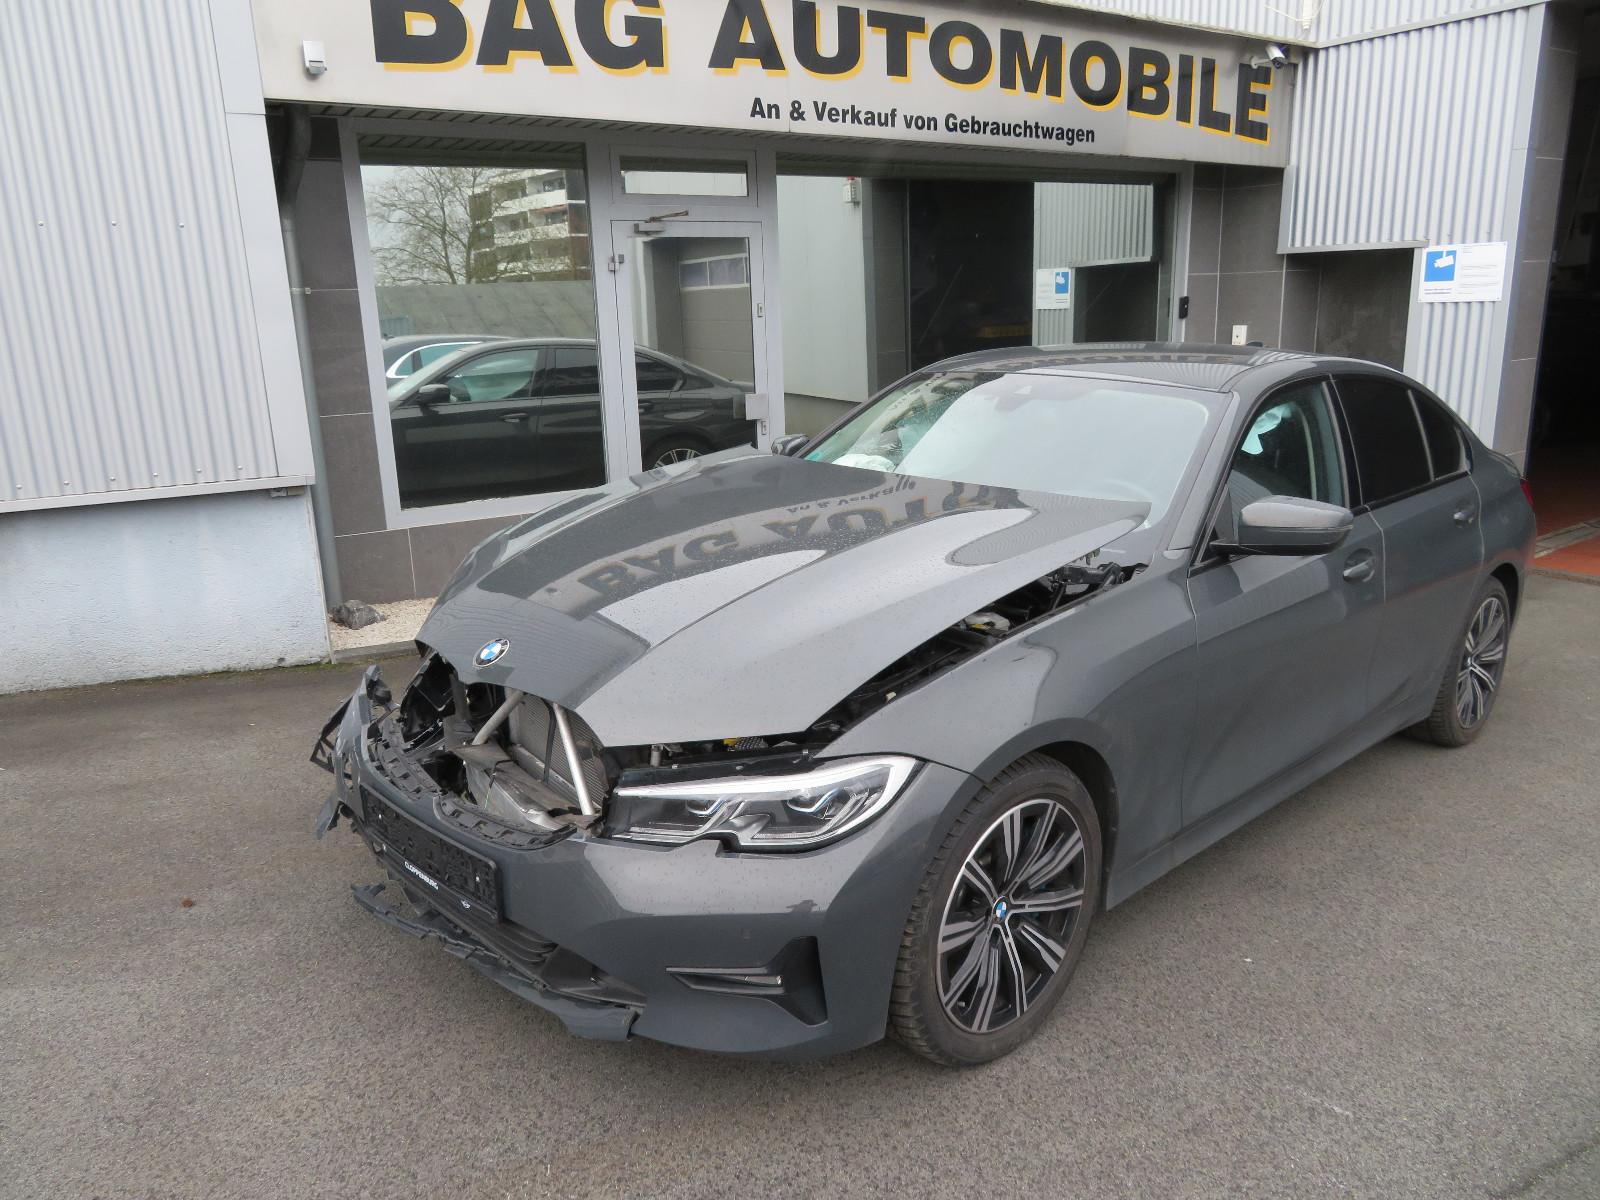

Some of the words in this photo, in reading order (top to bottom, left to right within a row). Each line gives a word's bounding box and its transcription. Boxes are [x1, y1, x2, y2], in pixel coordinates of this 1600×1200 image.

[370, 0, 668, 73] BAG
[708, 0, 1272, 143] AUTOMOBILE
[750, 97, 780, 119] An
[789, 100, 806, 121] &
[814, 101, 897, 128] Verkauf
[903, 112, 938, 131] von
[945, 113, 1096, 146] Gebrauchtwagen
